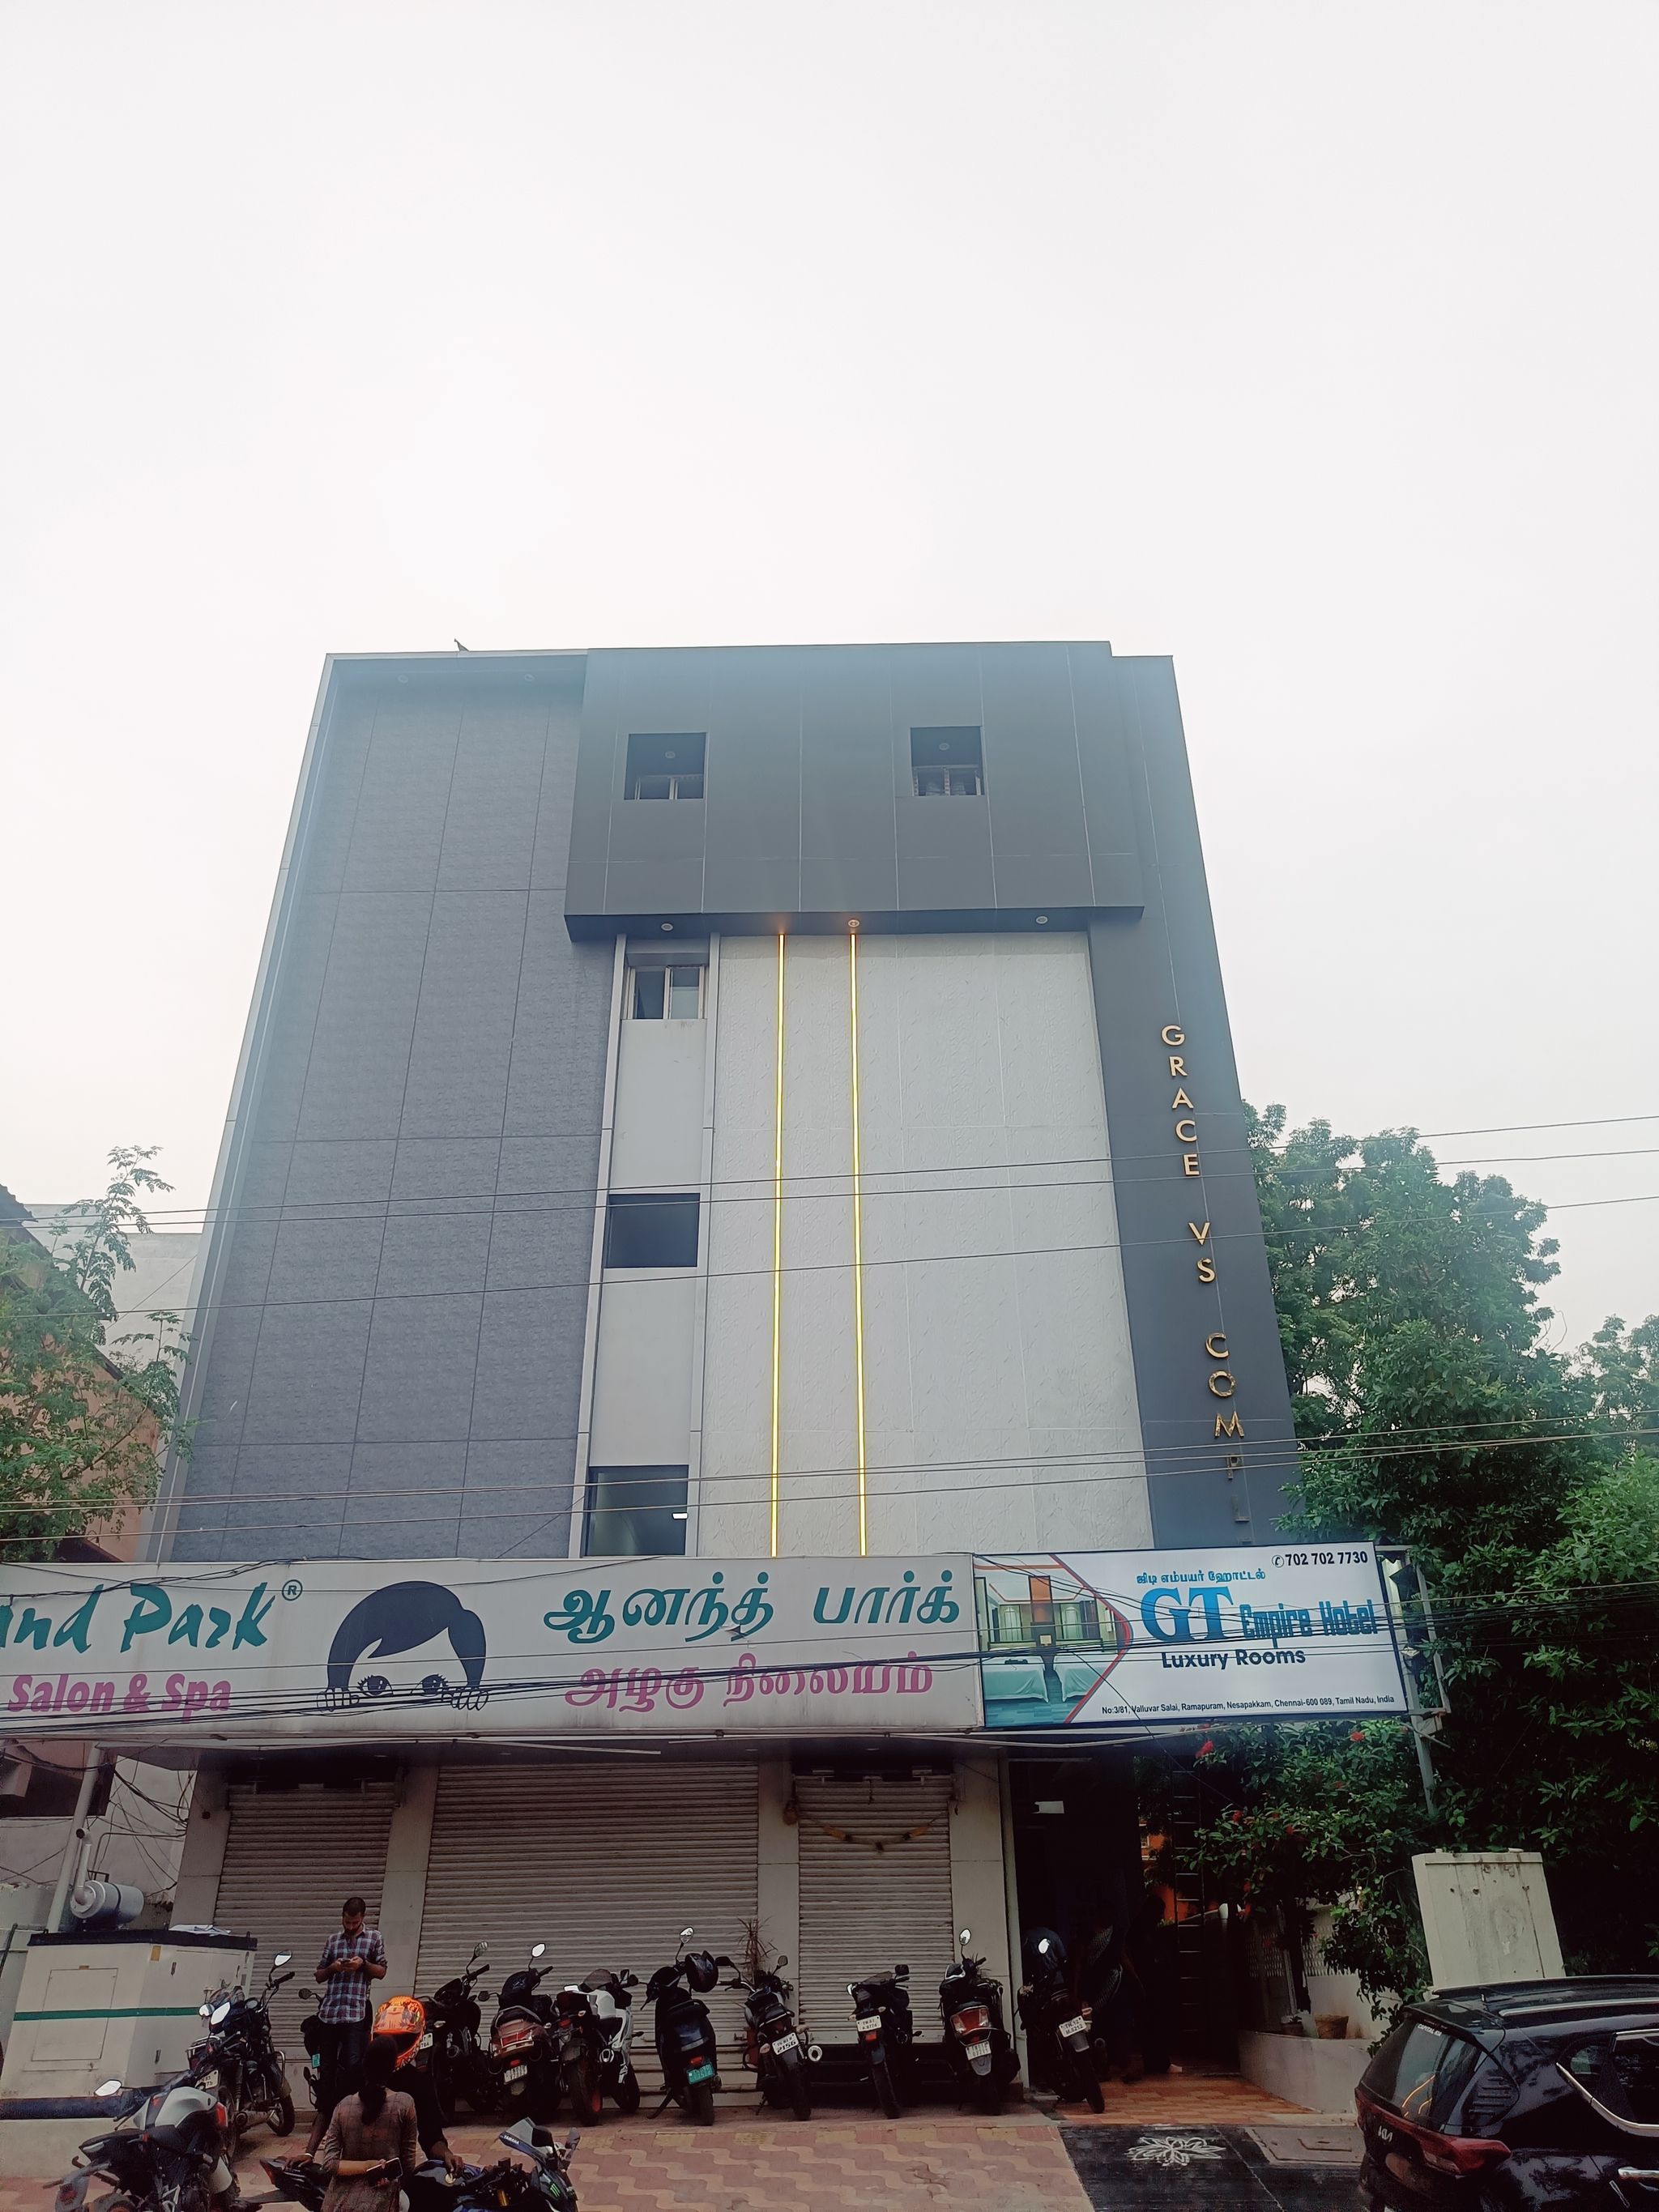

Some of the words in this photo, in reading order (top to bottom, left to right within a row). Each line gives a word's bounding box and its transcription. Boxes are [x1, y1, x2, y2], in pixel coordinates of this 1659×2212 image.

[1161, 1025, 1201, 1176] GRACE
[1188, 1221, 1216, 1284] VS
[1205, 1332, 1252, 1545] COMPL
[1161, 1570, 1205, 1583] எம்பயர்
[1285, 1554, 1308, 1566] 702
[1311, 1553, 1334, 1566] 702
[1337, 1551, 1368, 1564] 7730
[120, 1581, 275, 1653] Park
[544, 1571, 774, 1643] ஆனந்த்
[812, 1570, 959, 1624] பார்க்
[1141, 1587, 1234, 1643] GT
[1239, 1603, 1312, 1649] Empire
[1319, 1599, 1377, 1635] Hotel
[1161, 1652, 1229, 1669] Luxury
[1235, 1648, 1306, 1665] Rooms
[8, 1673, 115, 1712] Salon
[123, 1673, 151, 1714] &
[163, 1673, 231, 1724] Spa
[565, 1666, 705, 1712] அழகு
[1132, 1704, 1159, 1713] Valluvar
[1161, 1703, 1180, 1712] Salai,
[1181, 1702, 1226, 1711] Ramapuram,
[1226, 1699, 1273, 1711] Nesapakkam,
[1274, 1698, 1319, 1707] Chennai-600
[1335, 1696, 1354, 1705] Tamil
[1354, 1695, 1376, 1704] Nadu,
[1377, 1694, 1395, 1703] India
[503, 2134, 520, 2146] YAMAHA
